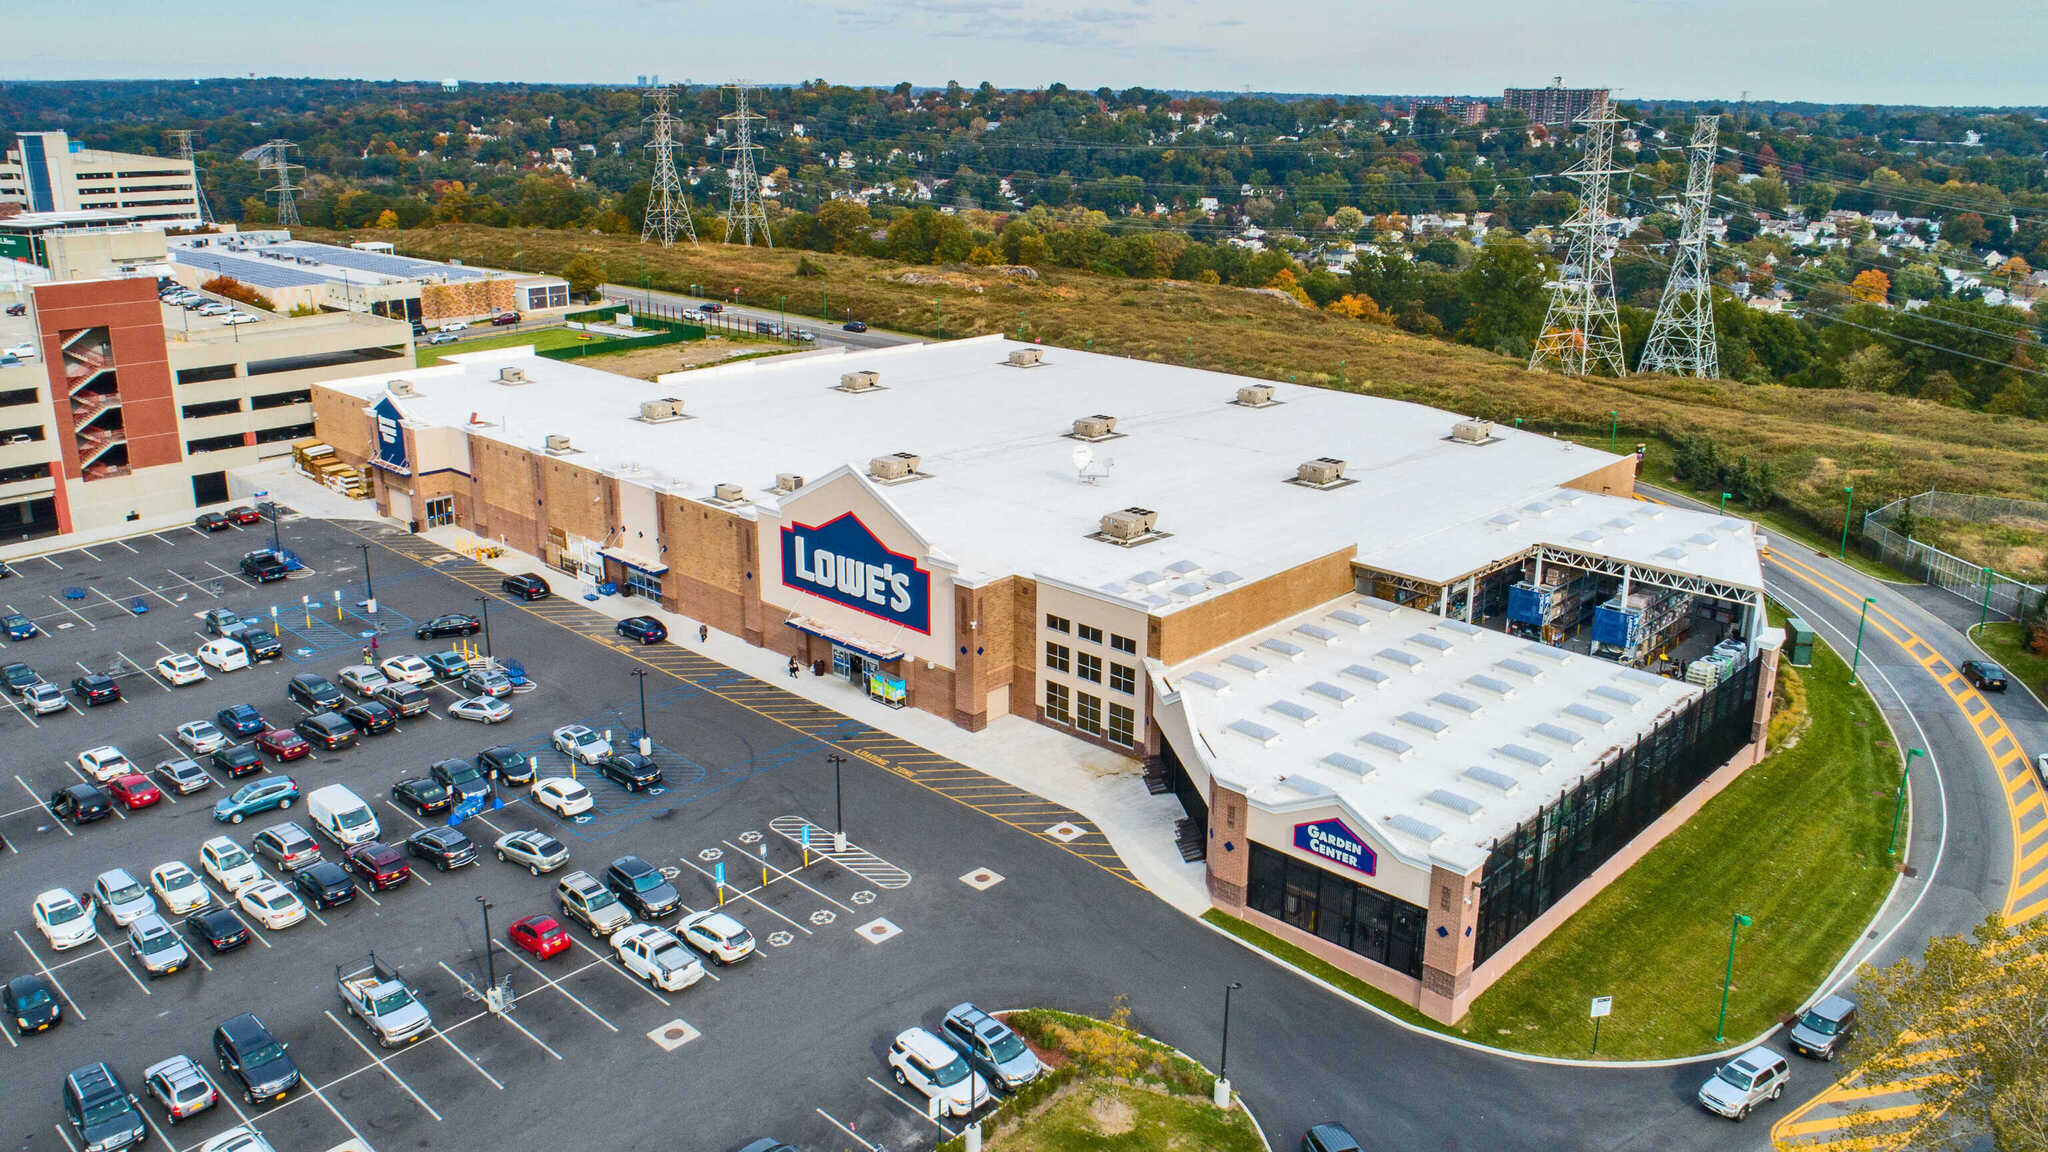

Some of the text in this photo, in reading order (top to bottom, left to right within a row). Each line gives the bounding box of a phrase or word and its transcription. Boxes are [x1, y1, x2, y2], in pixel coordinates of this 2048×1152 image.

[794, 535, 912, 613] LOWE'S
[1307, 824, 1362, 855] GARDEN
[1309, 838, 1358, 867] CENTER
